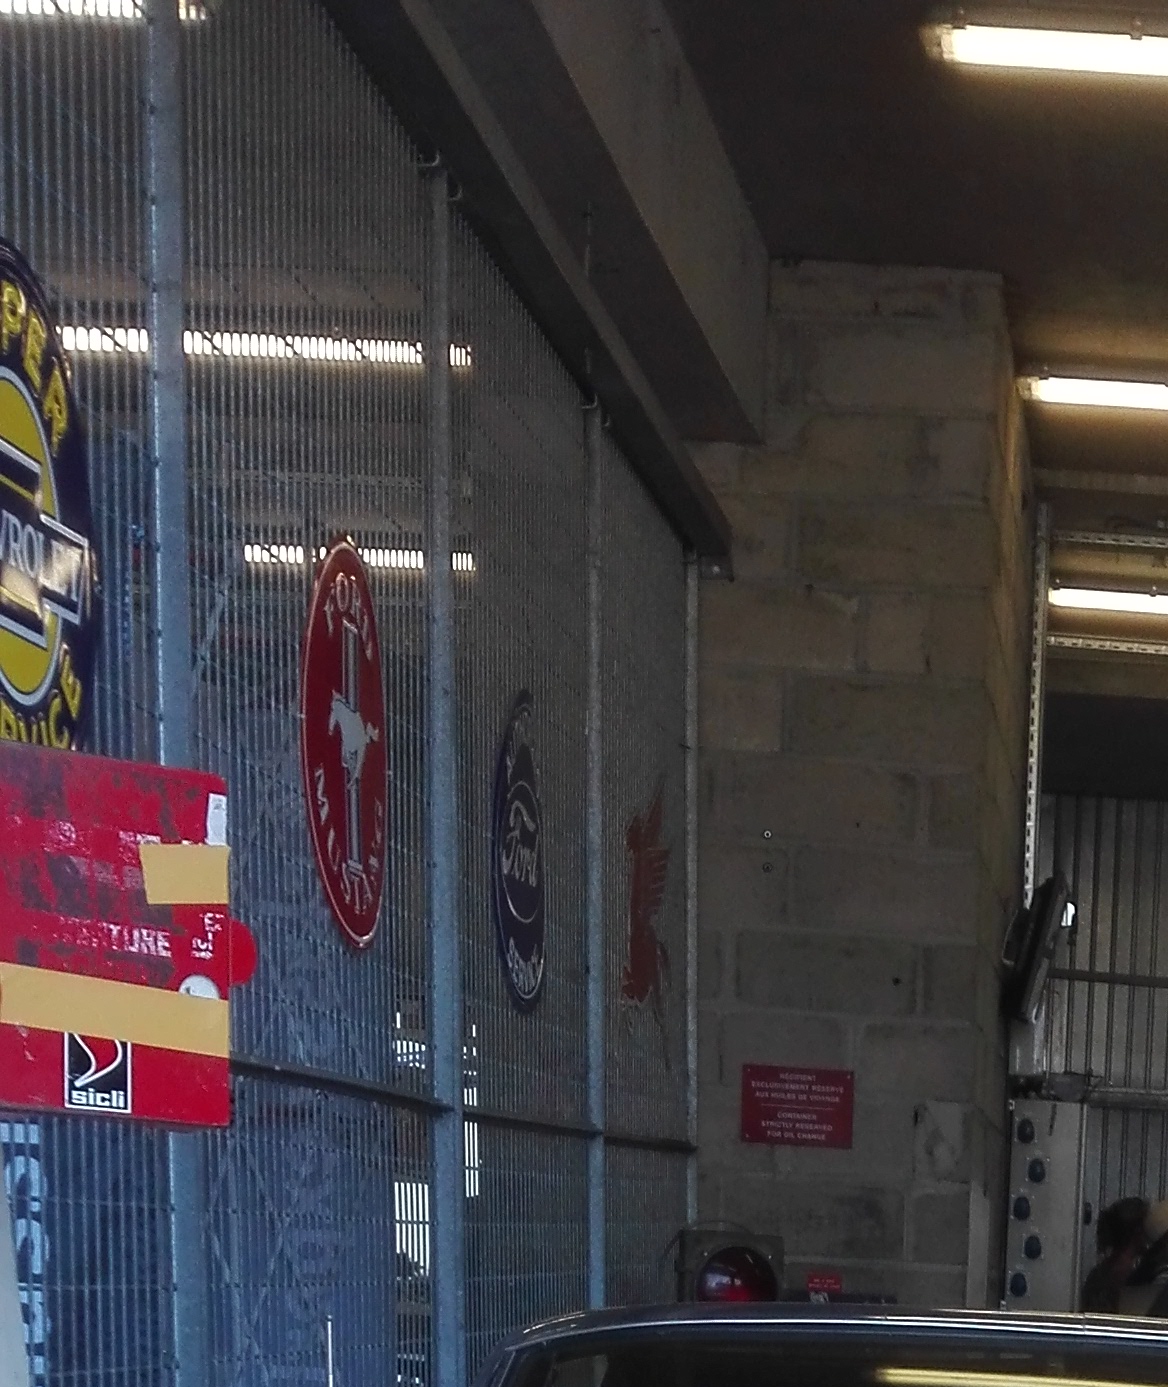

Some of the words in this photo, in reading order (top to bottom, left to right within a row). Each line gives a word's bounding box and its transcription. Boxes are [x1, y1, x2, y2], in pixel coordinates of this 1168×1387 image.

[323, 571, 373, 661] FORD
[502, 801, 537, 888] Ford
[71, 1087, 125, 1108] sicli
